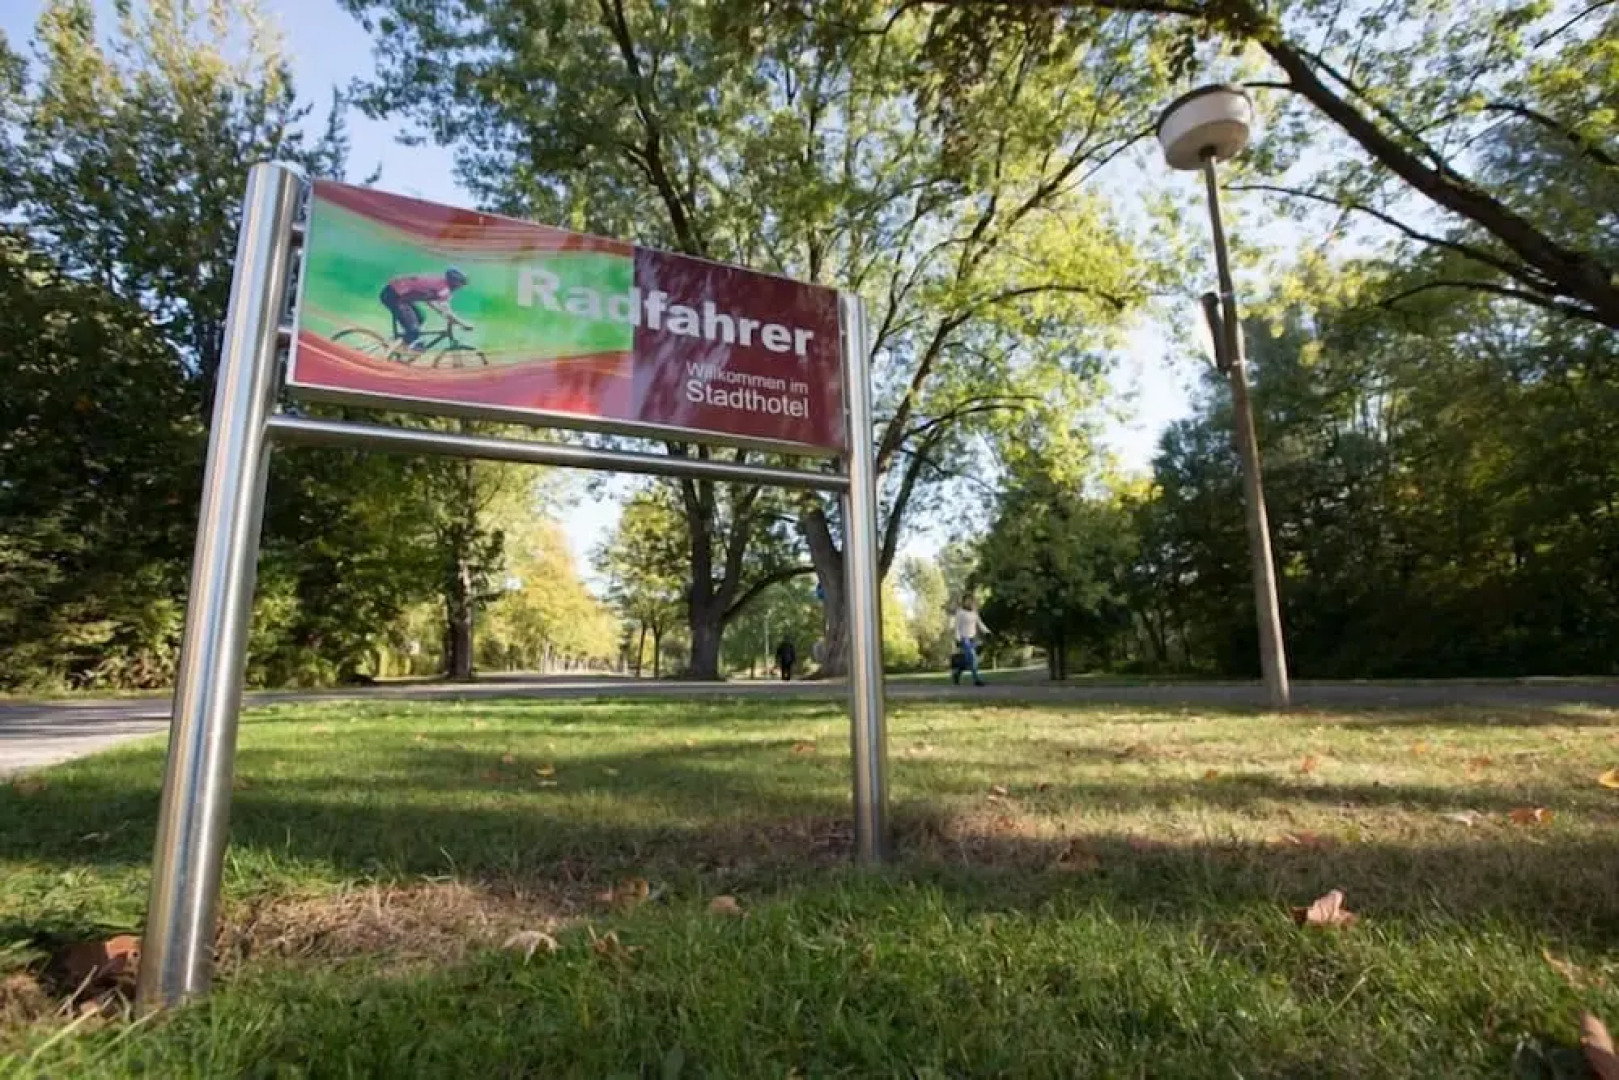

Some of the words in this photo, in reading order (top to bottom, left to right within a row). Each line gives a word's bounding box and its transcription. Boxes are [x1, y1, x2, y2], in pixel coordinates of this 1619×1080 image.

[517, 267, 814, 356] Radfahrer
[686, 360, 785, 391] Willkommen
[790, 379, 809, 394] im
[686, 379, 809, 419] Stadthotel
